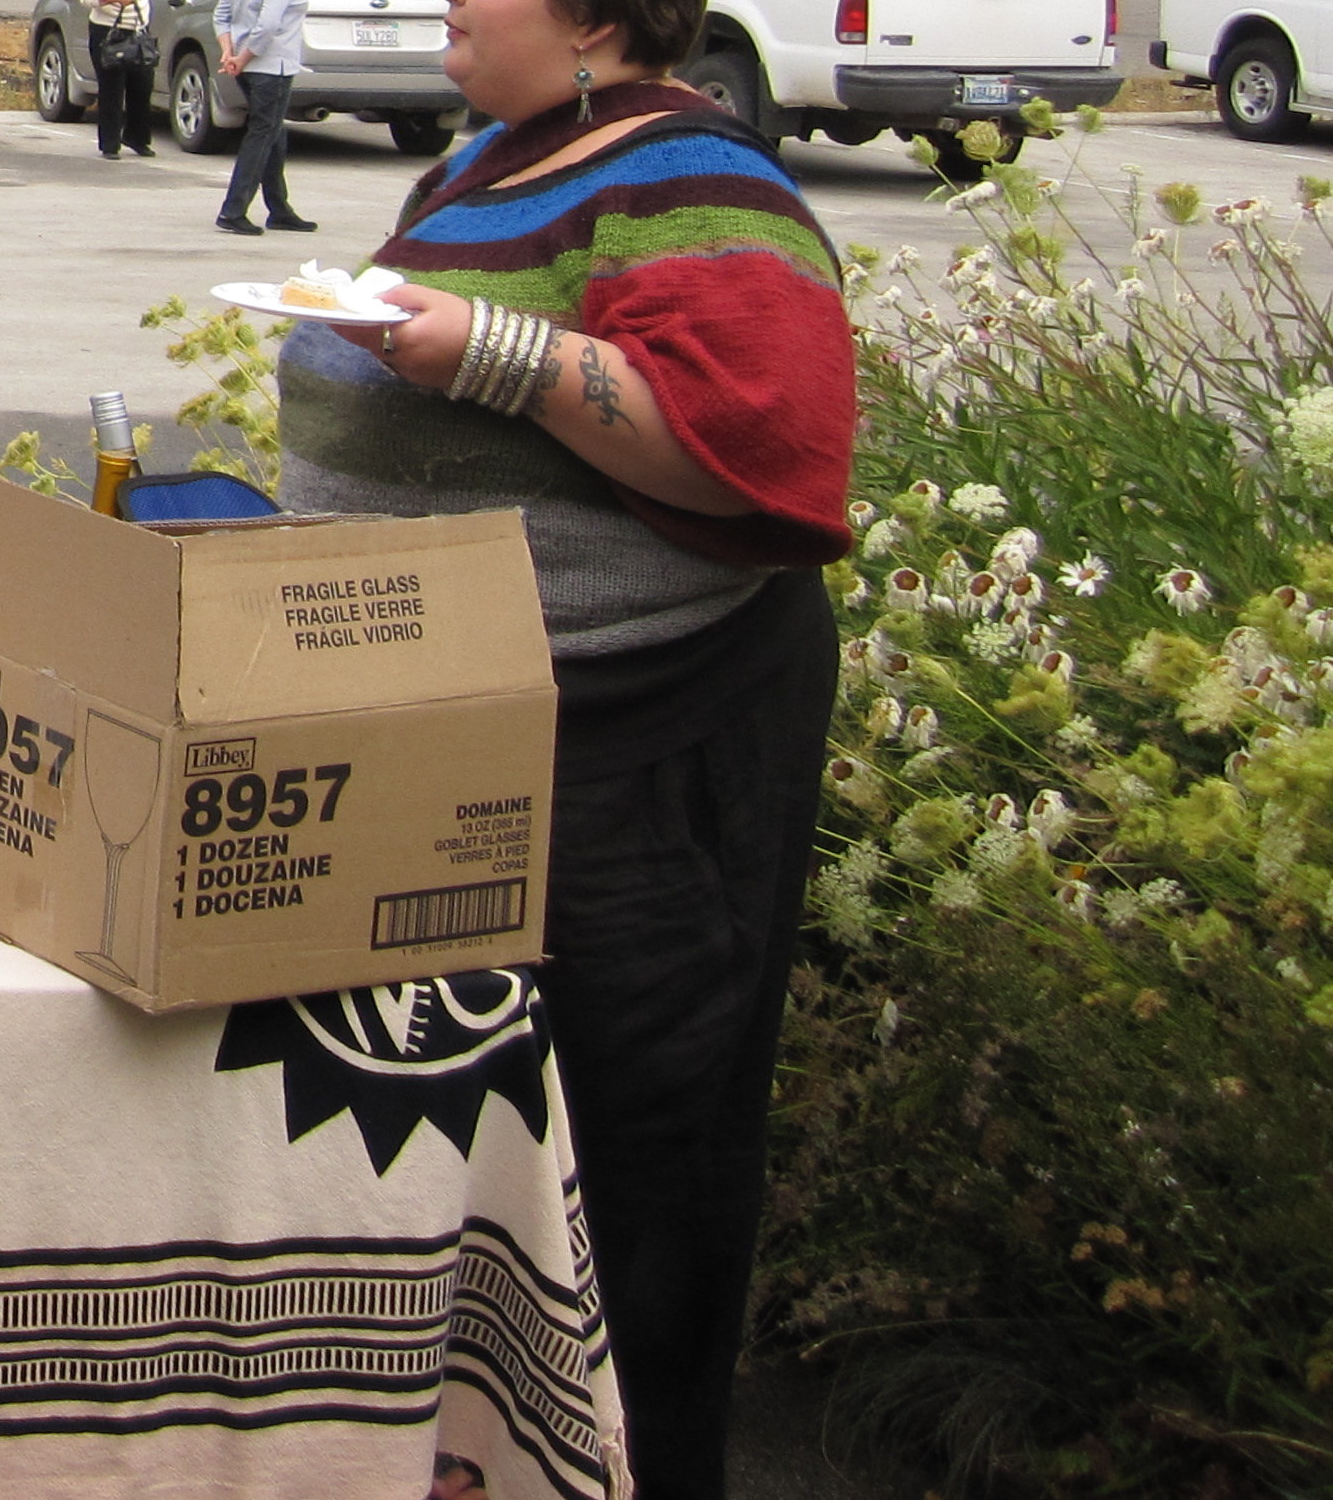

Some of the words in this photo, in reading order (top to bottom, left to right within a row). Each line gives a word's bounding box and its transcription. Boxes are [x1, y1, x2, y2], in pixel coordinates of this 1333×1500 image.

[281, 580, 358, 603] FRAGILE
[361, 574, 421, 597] GLASS
[285, 603, 362, 627] FRAGILE
[364, 598, 425, 620] VERRE
[295, 626, 360, 651] FRÁGIL
[363, 621, 424, 644] VIDRIO
[192, 745, 251, 769] Libbey
[180, 762, 352, 838] 8957
[456, 796, 533, 821] DOMAINE
[434, 836, 479, 852] GOBLET
[481, 829, 531, 846] GLASSES
[462, 823, 474, 834] 13
[475, 819, 490, 832] OZ
[176, 844, 189, 867] 1
[199, 833, 290, 865] DOZEN
[449, 849, 493, 864] VERRES
[505, 843, 530, 857] PIED
[174, 871, 186, 893] 1
[197, 853, 333, 891] DOUZAINE
[491, 857, 529, 874] COPAS
[172, 897, 184, 920] 1
[195, 884, 305, 918] DOCENA
